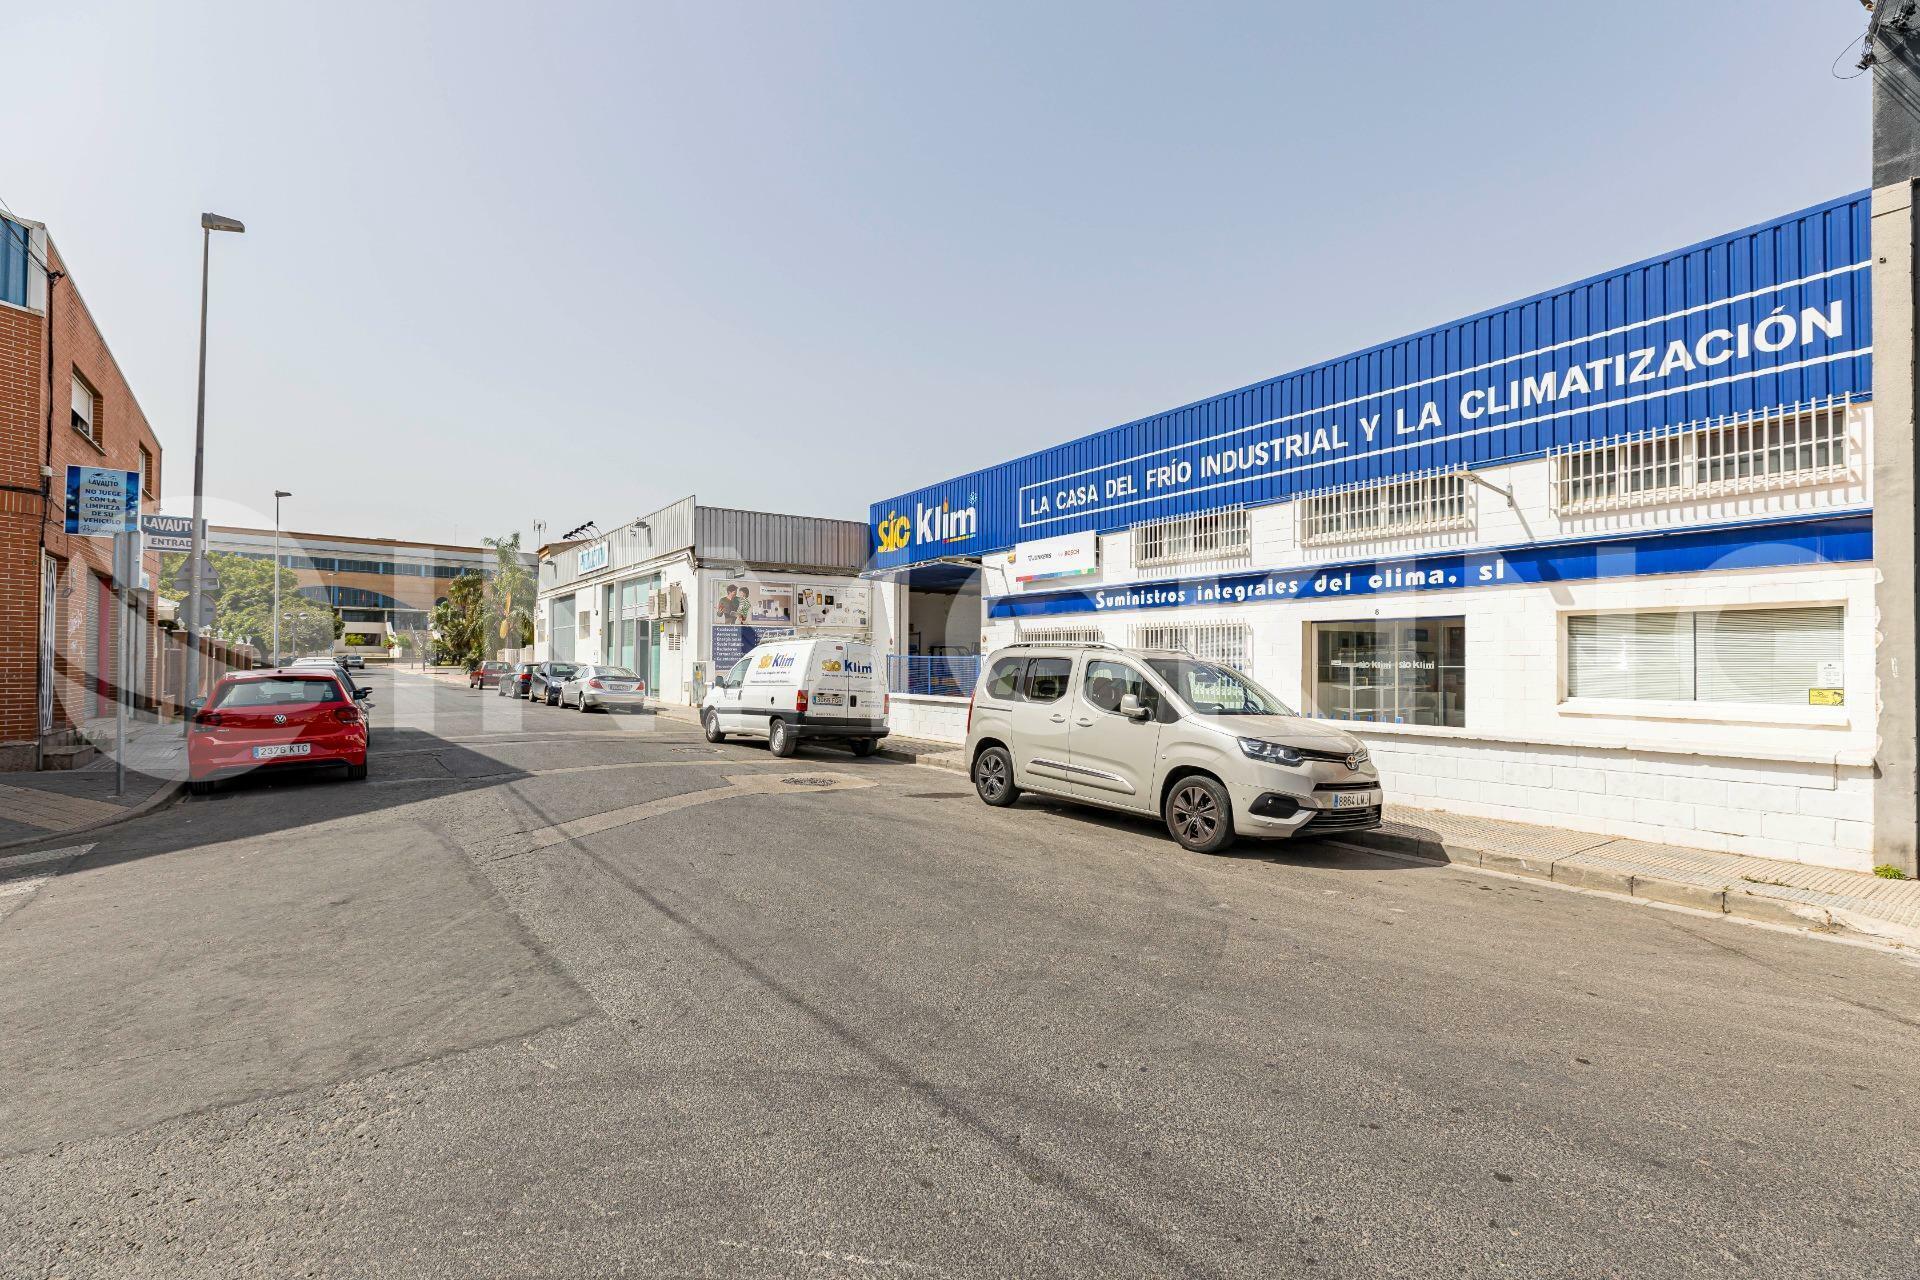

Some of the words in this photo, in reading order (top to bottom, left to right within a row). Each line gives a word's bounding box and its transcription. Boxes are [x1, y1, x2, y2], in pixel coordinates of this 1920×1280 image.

[1030, 494, 1049, 515] LA
[1056, 484, 1098, 510] CASA
[1106, 474, 1137, 503] DEL
[1146, 458, 1192, 491] FRÍO
[1200, 424, 1348, 478] INDUSTRIAL
[1359, 414, 1381, 442] Y
[1396, 400, 1442, 435] LA
[1459, 299, 1844, 420] CLIMATIZACIÓN
[88, 478, 119, 487] LAVAUTO
[151, 537, 193, 548] ENTRAD
[1095, 588, 1186, 609] Suministros
[1197, 576, 1299, 603] integrales
[1314, 572, 1352, 594] del
[289, 744, 308, 753] KTC
